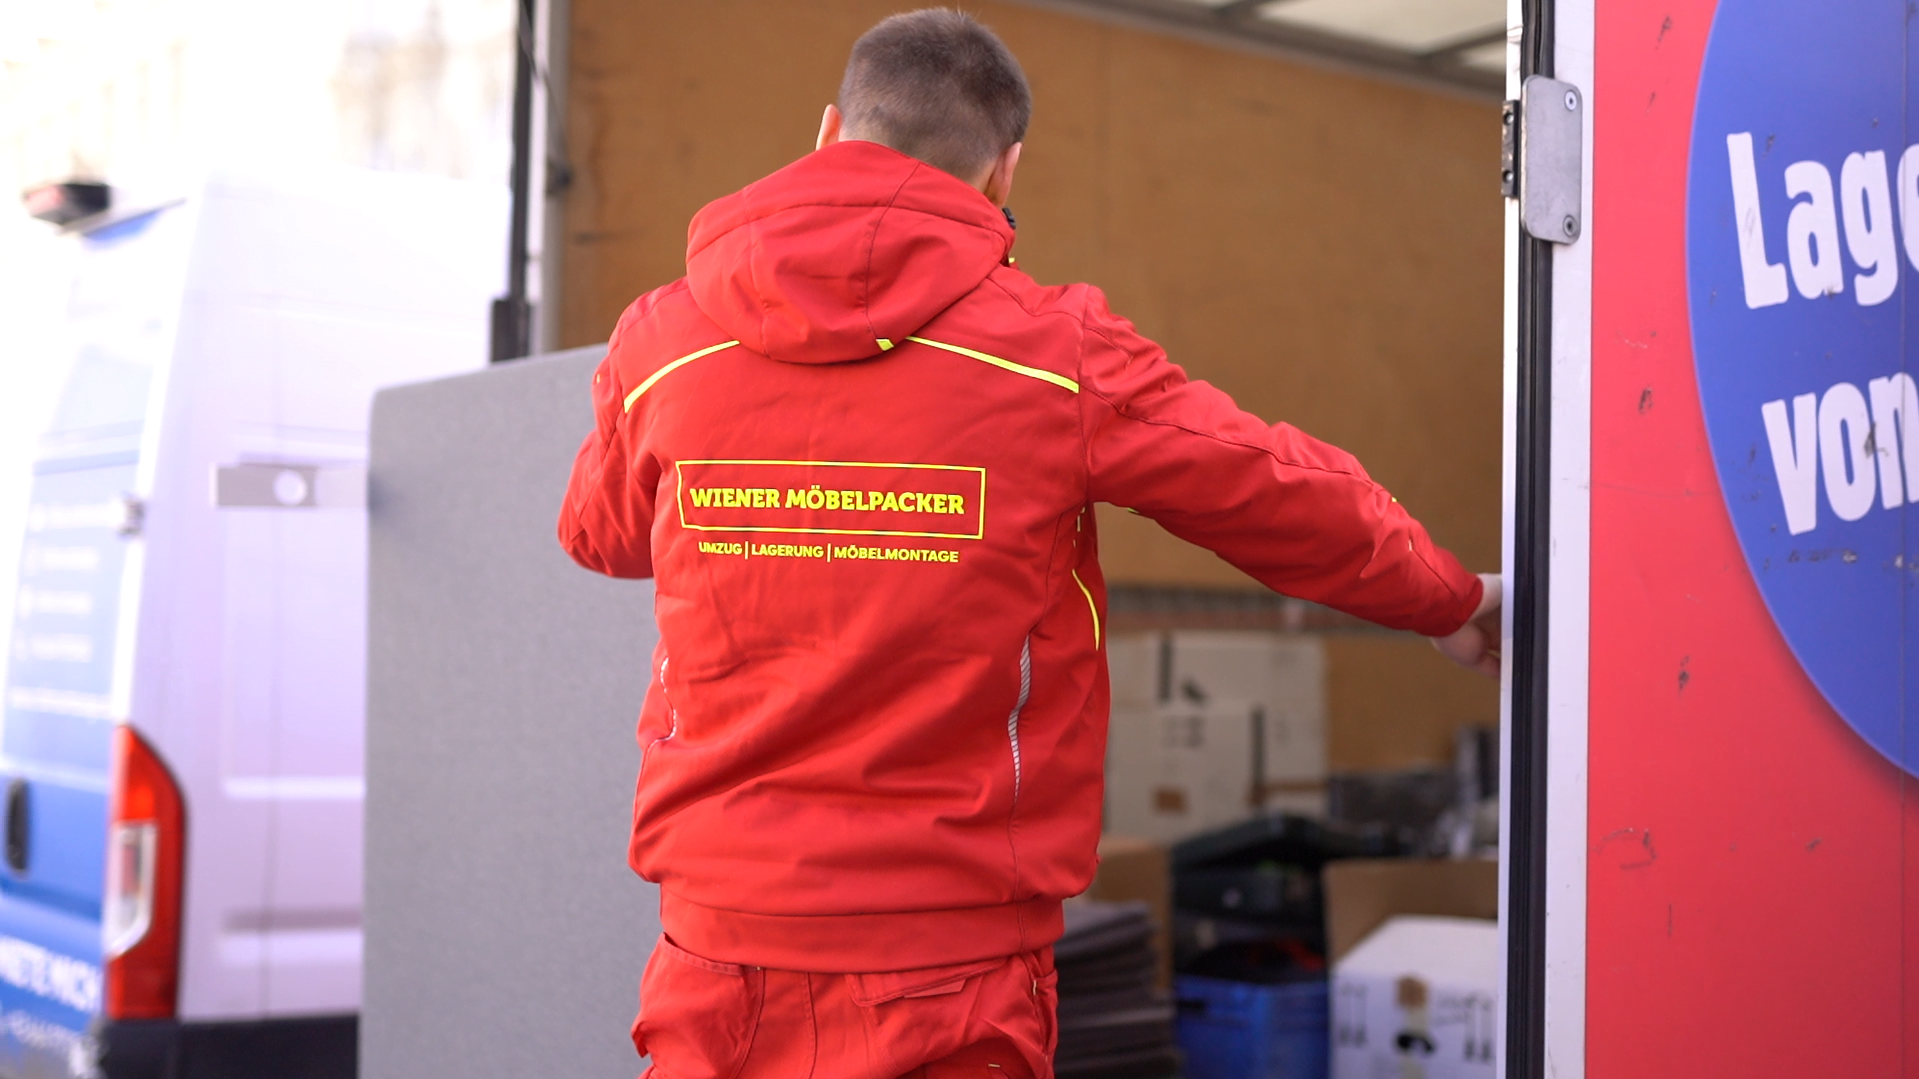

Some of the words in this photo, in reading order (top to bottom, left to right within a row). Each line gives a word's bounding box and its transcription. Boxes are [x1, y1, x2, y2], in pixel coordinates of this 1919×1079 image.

[1761, 372, 1919, 535] von
[689, 487, 780, 508] WIENER
[784, 484, 965, 515] MÖBELPACKER
[698, 541, 743, 556] UMZUG
[751, 543, 825, 559] LAGERUNG
[834, 544, 960, 563] MÖBELMONTAGE
